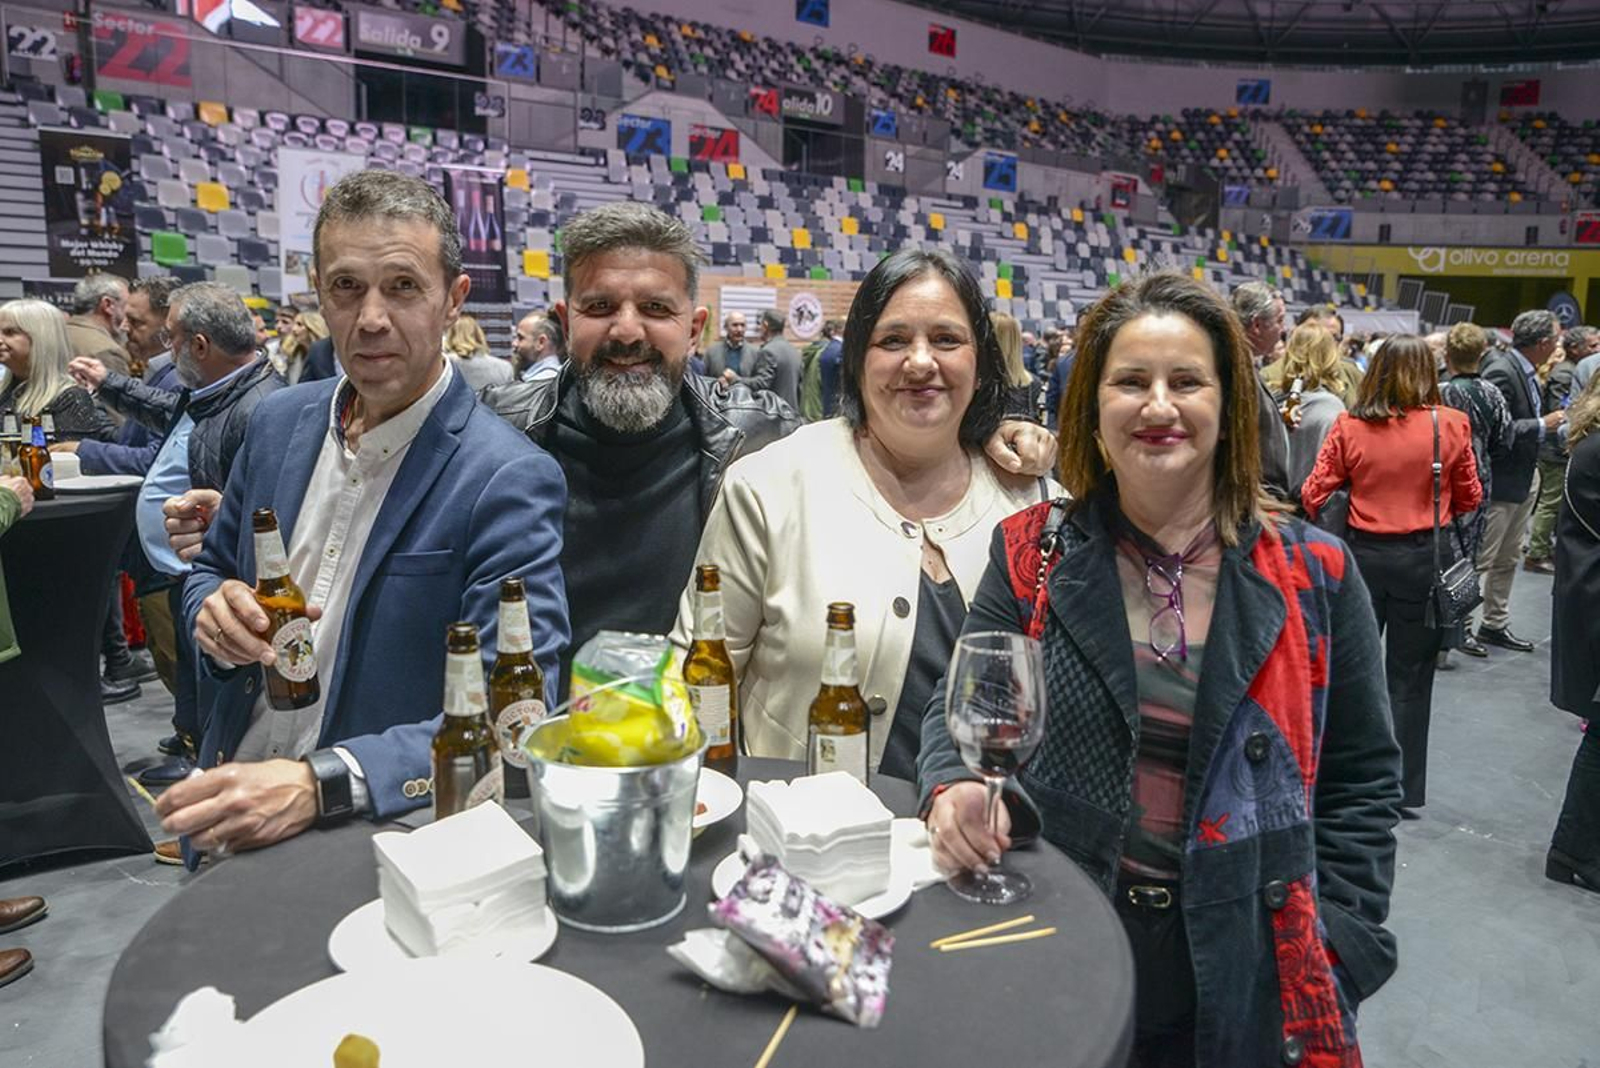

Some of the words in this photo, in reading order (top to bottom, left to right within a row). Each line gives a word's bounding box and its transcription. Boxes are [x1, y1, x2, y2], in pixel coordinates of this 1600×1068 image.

[94, 13, 154, 34] Sector
[9, 26, 57, 60] 22
[361, 24, 421, 48] Salida
[431, 24, 449, 51] 9
[96, 16, 192, 87] 22
[815, 93, 832, 115] 10
[885, 151, 904, 173] 24
[1450, 248, 1498, 266] olivo
[1505, 252, 1569, 266] arena
